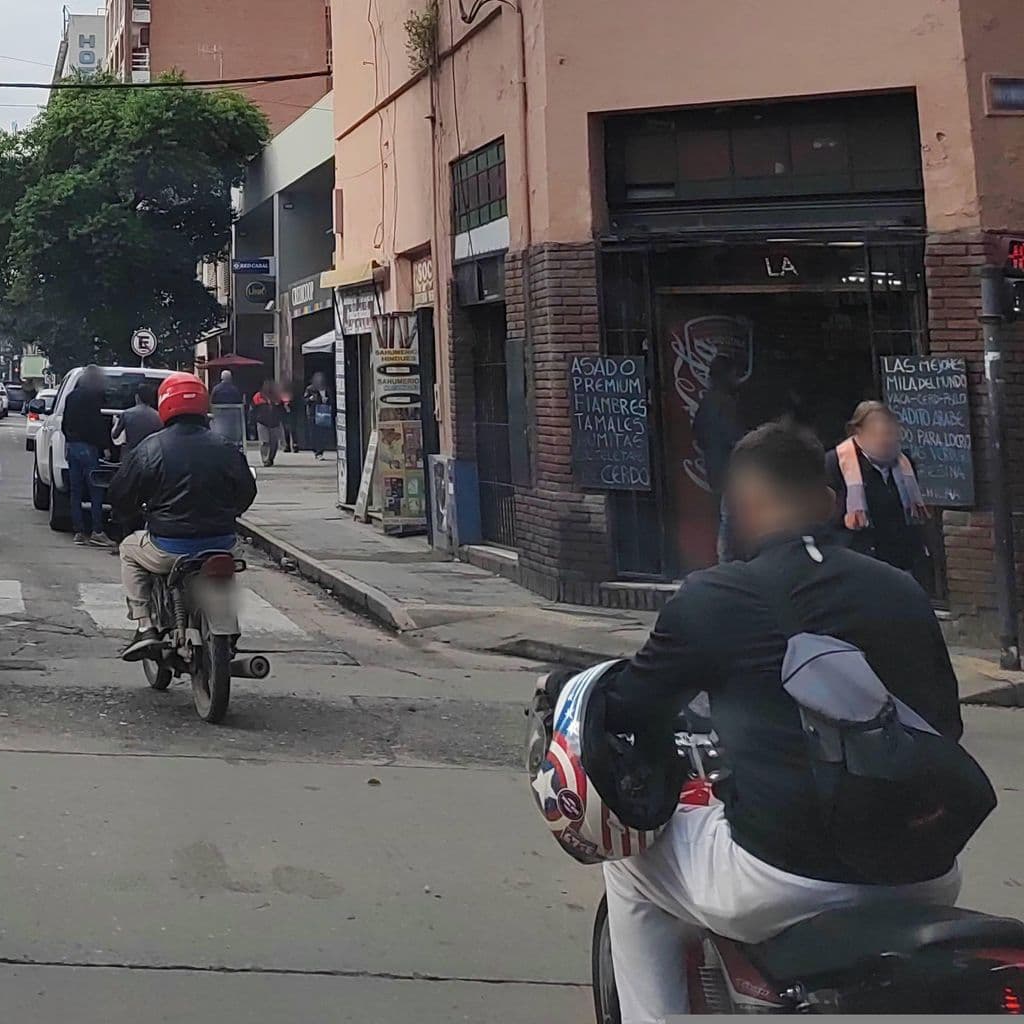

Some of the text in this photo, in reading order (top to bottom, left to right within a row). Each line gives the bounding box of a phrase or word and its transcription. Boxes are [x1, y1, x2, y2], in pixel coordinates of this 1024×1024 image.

[765, 257, 799, 276] LA
[571, 357, 636, 376] ASADO
[884, 356, 915, 373] LAS
[573, 376, 641, 394] PREMIUM
[574, 394, 647, 417] FIAMBRES
[918, 431, 942, 447] PARA
[600, 465, 650, 486] CERDO
